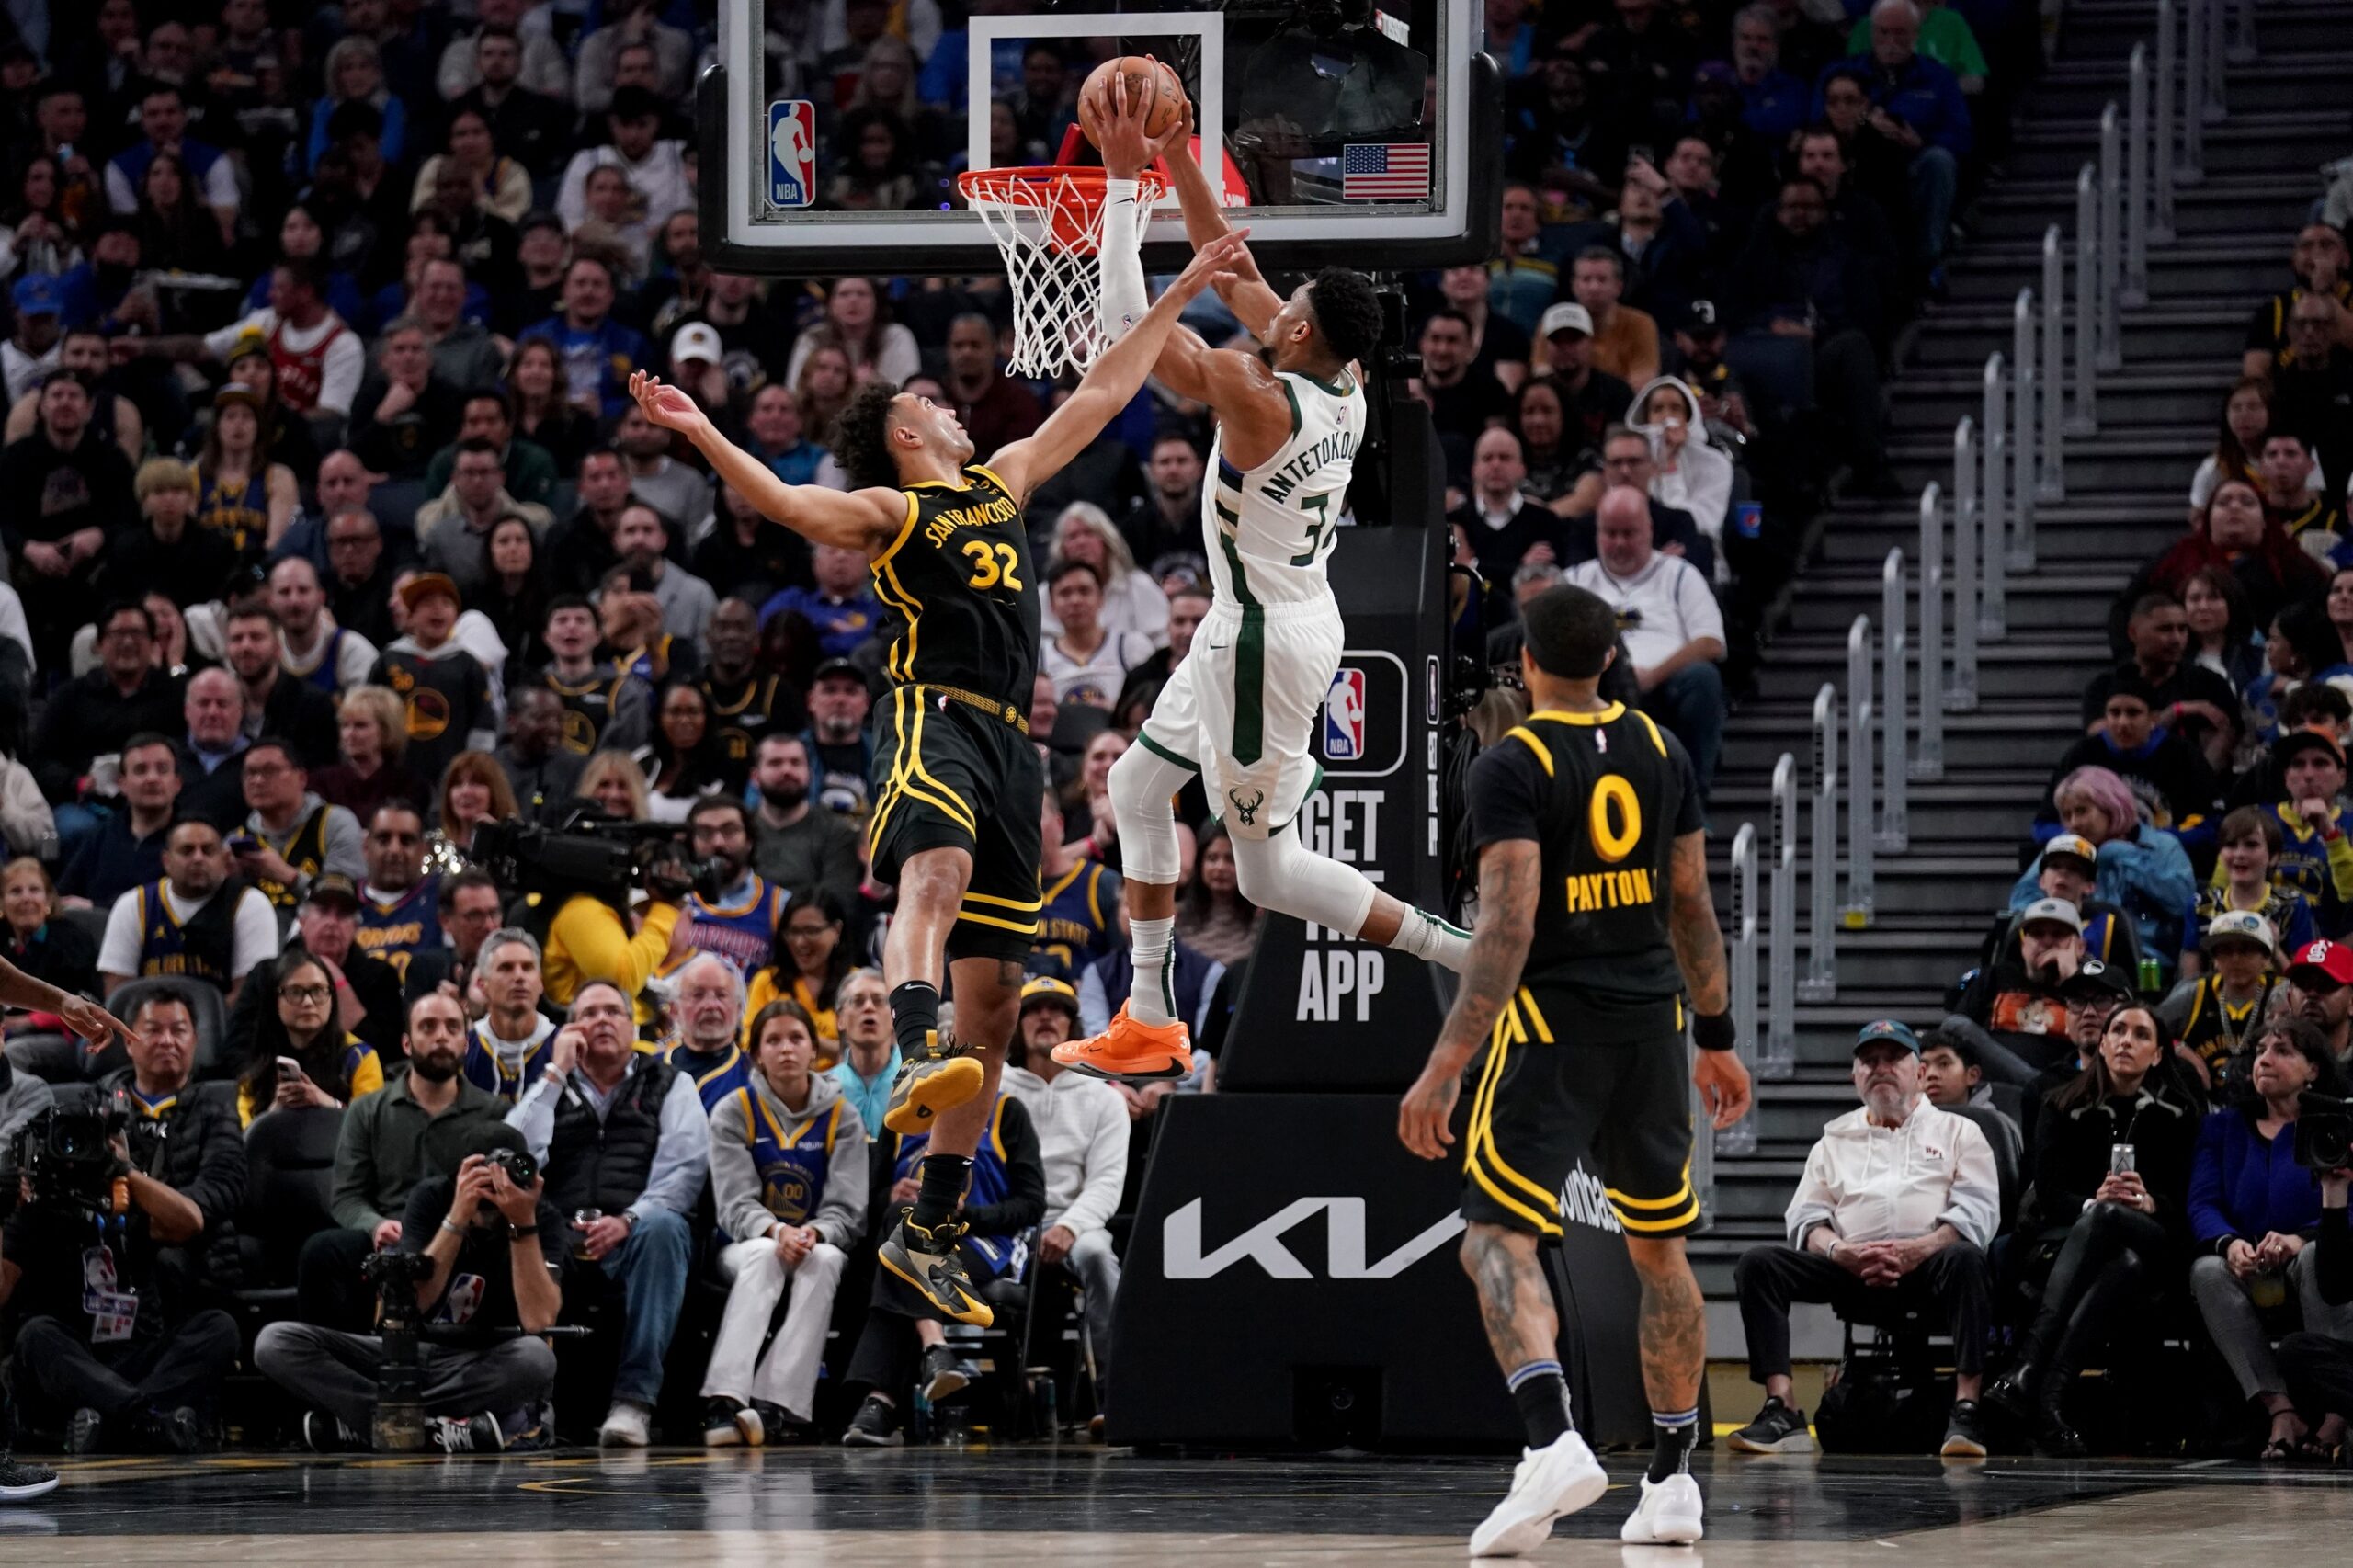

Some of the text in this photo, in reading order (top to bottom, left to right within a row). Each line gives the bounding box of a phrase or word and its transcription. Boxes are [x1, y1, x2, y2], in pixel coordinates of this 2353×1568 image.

[776, 183, 798, 200] NBA
[926, 496, 1017, 549] SAN FRANCISCO
[1290, 493, 1339, 567] 3
[961, 540, 1022, 592] 32
[1329, 738, 1349, 754] NBA
[1301, 790, 1385, 862] GET
[1589, 774, 1642, 863] 0
[1566, 868, 1653, 914] PAYTON
[1296, 949, 1385, 1022] APP
